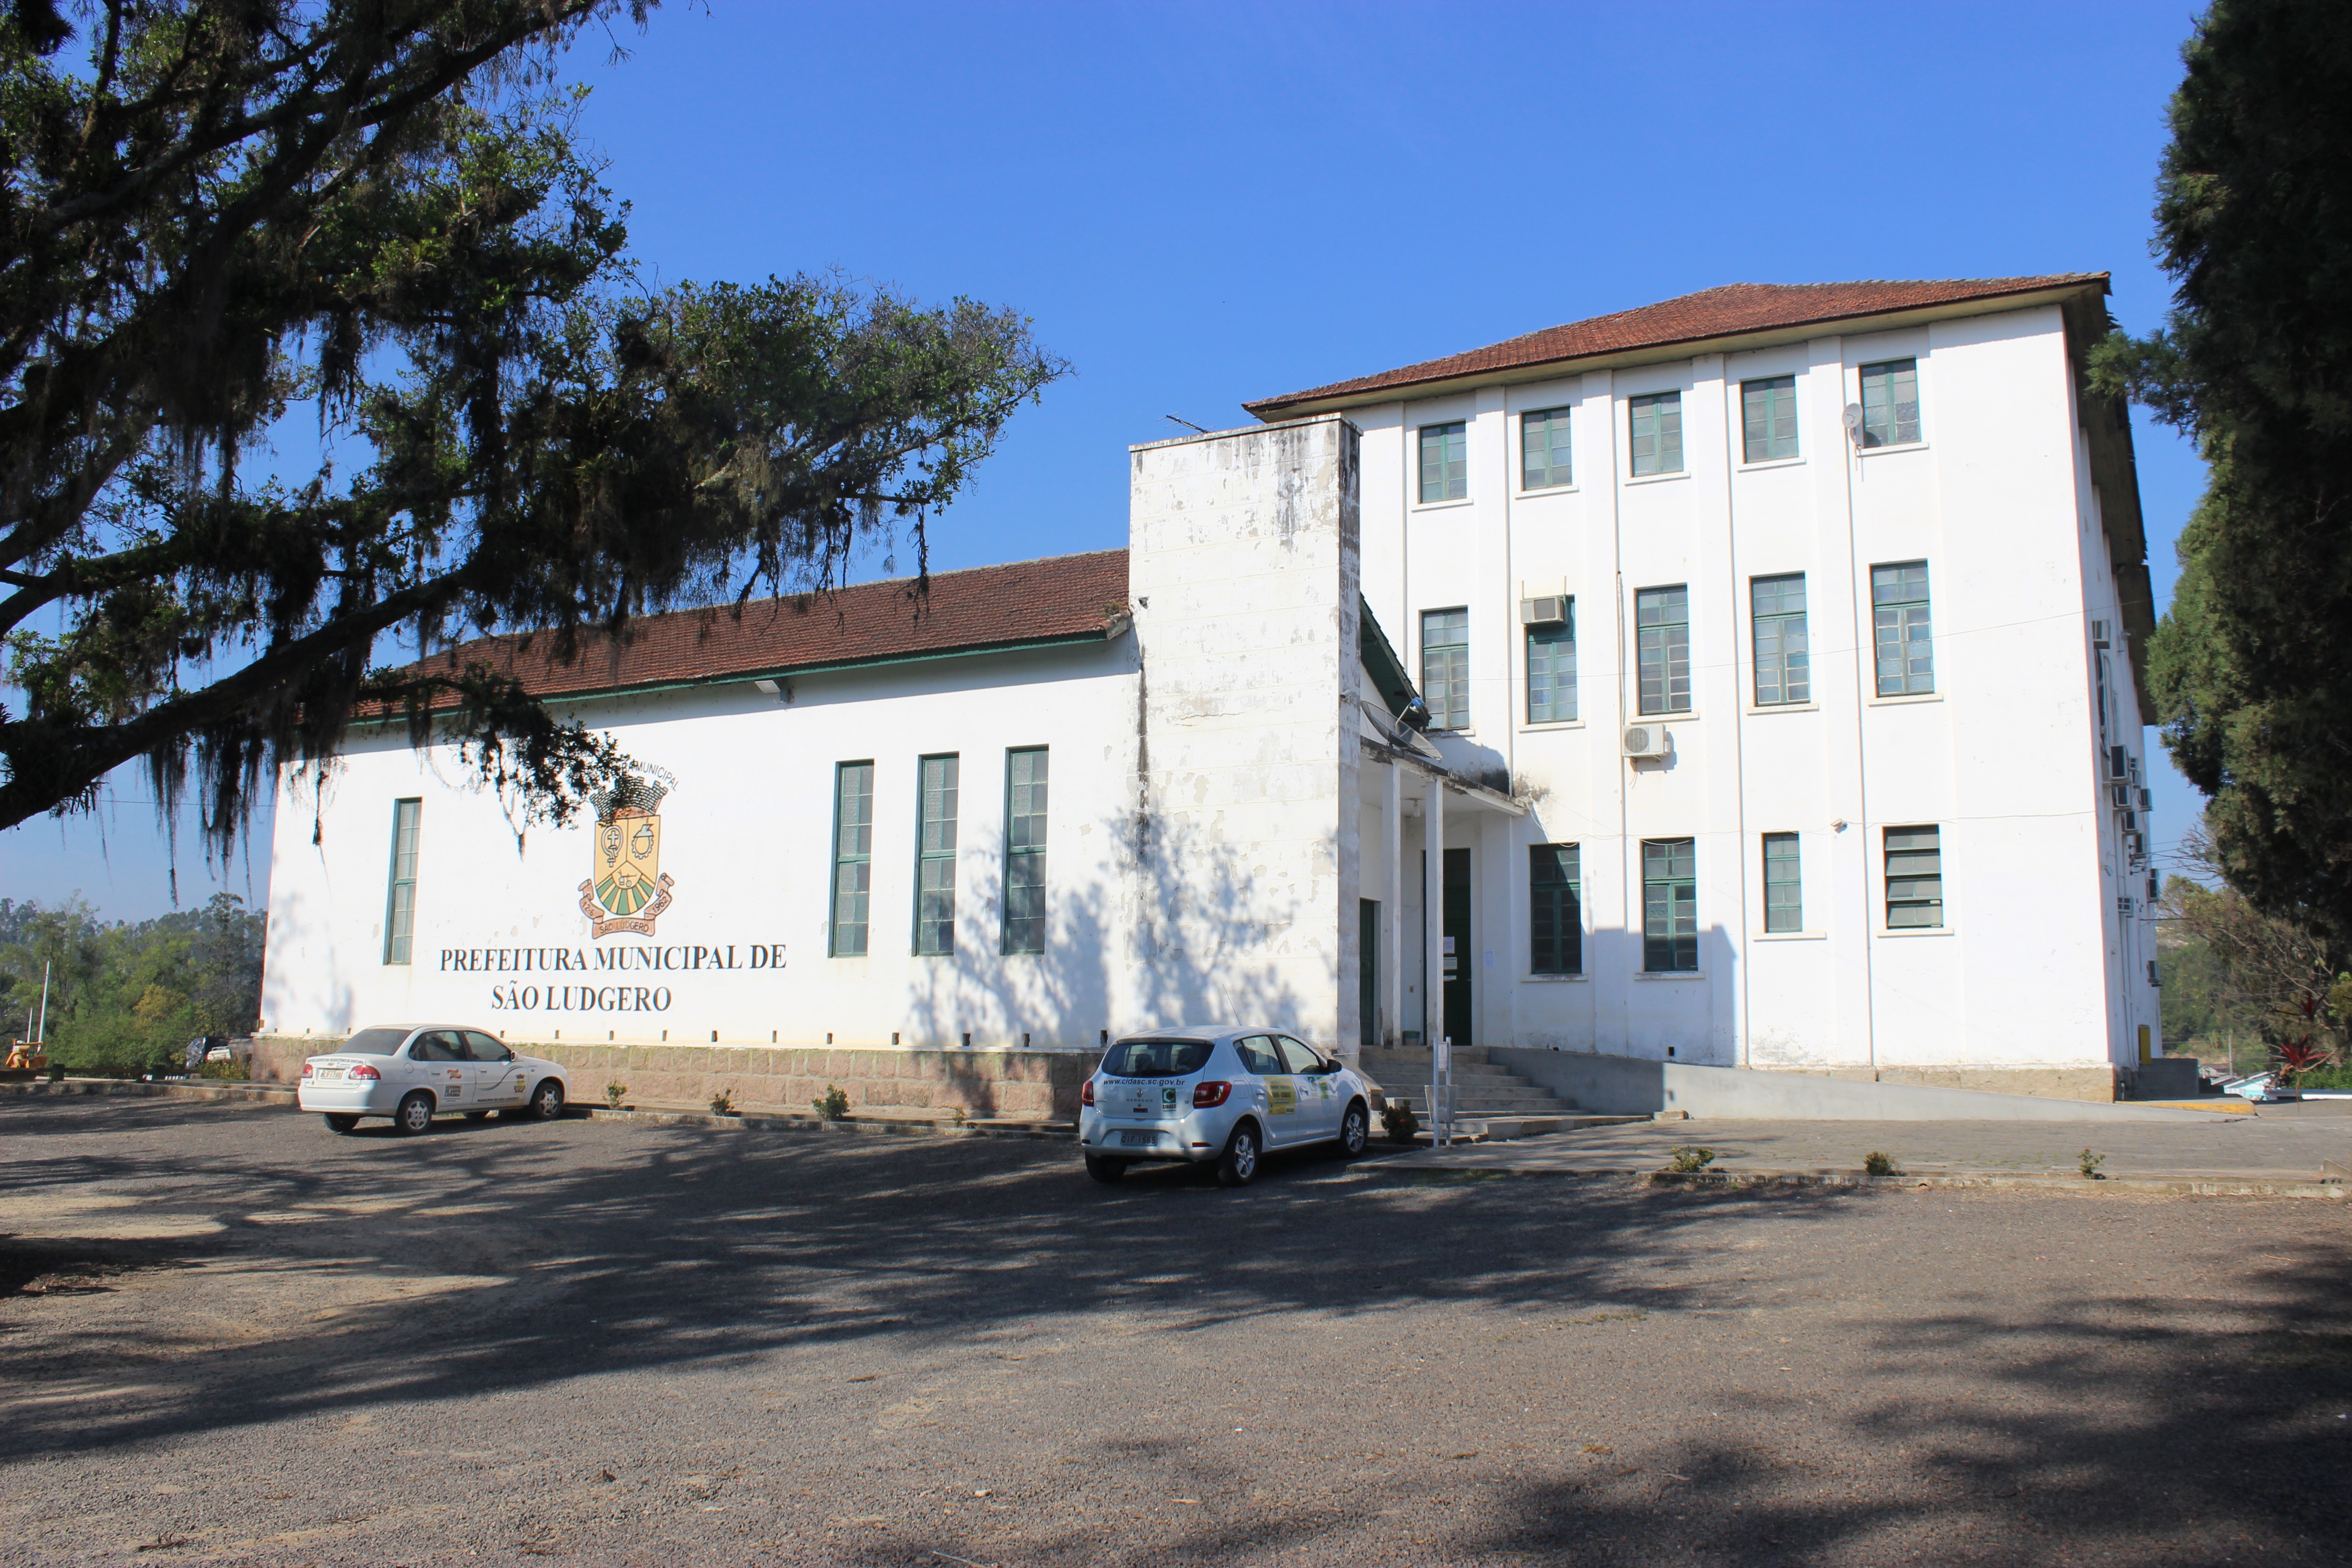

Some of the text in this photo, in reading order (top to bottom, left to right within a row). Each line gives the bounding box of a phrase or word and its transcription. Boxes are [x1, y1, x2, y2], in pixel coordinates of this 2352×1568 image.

[636, 761, 679, 792] MUNICIPAL
[582, 901, 595, 916] 12-6
[652, 896, 669, 913] 1962
[599, 921, 649, 934] SÃO LUDGERO
[440, 944, 787, 971] PREFEITURA MUNICIPAL DE
[491, 980, 672, 1011] SÃO LUDGERO
[1103, 1078, 1185, 1087] www.cidasc.sc.gov.br
